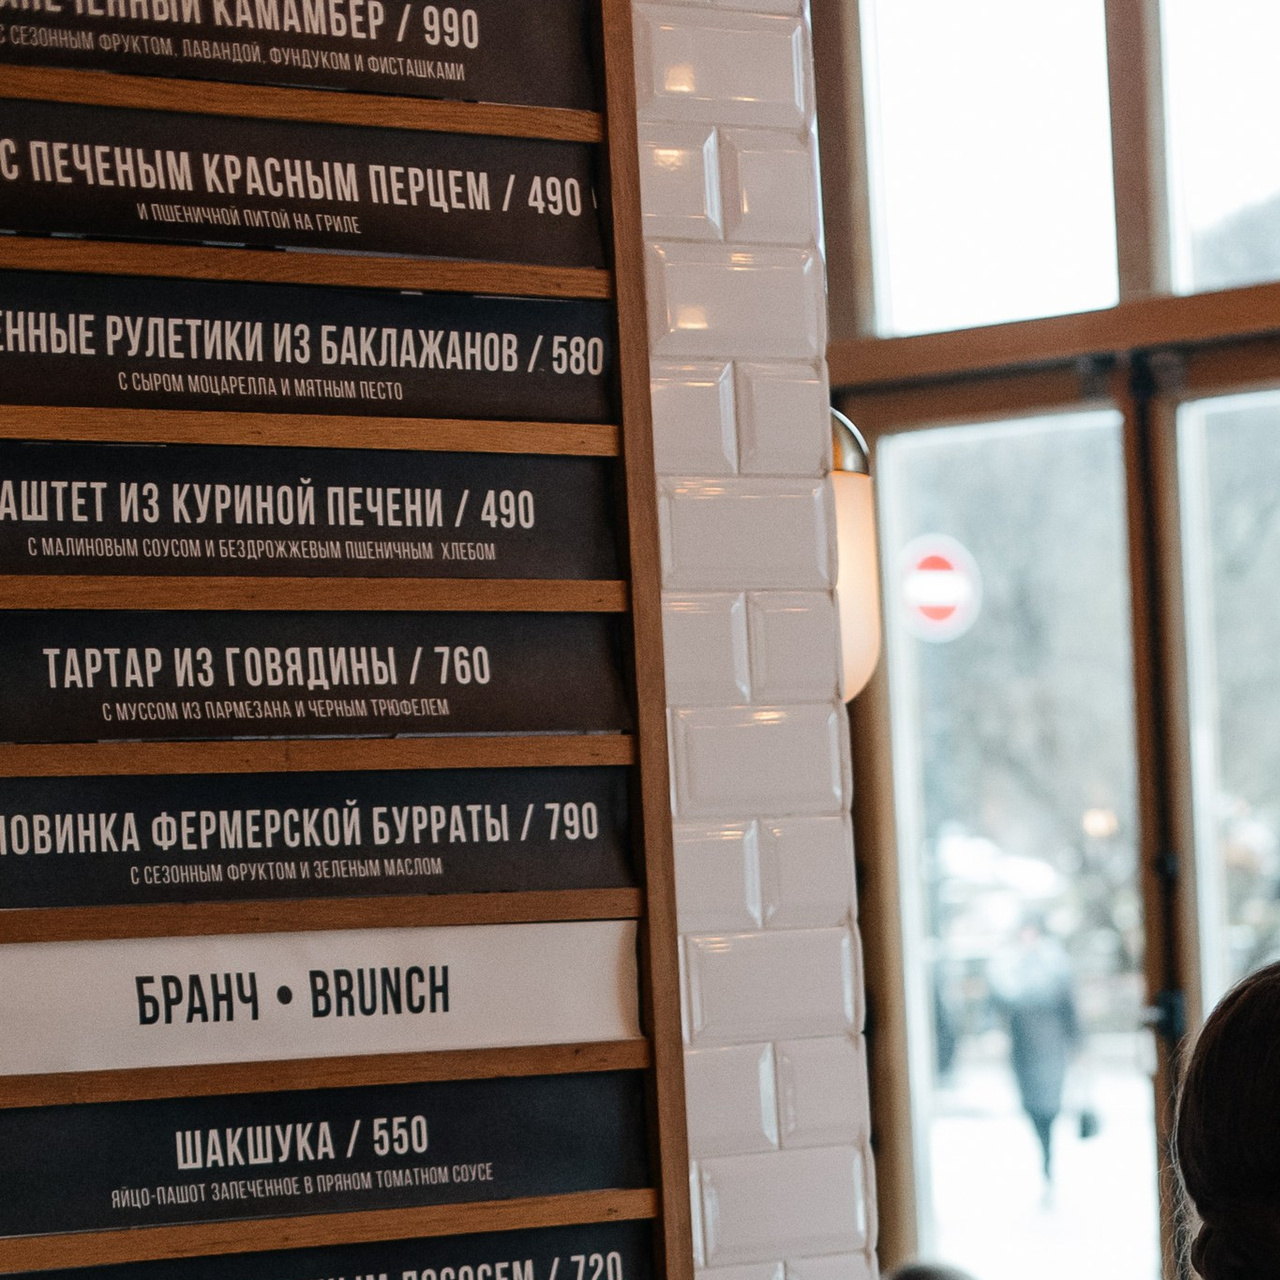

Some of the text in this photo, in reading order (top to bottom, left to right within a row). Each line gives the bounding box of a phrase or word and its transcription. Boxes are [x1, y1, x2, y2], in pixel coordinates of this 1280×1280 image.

[397, 4, 411, 42] /
[423, 5, 479, 49] 990
[10, 25, 94, 49] СЕЗОННЫМ
[269, 47, 351, 71] ФУНДУКОМ
[354, 54, 364, 72] И
[367, 55, 465, 81] ФИСТАШКАМИ
[0, 138, 582, 216] С ПЕЧЕНЫМ КРАСНЫМ ПЕРЦЕМ / 490
[136, 203, 362, 234] И ПШЕНИЧНОЙ ПИТОЙ НА ГРИЛЕ
[106, 315, 263, 362] РУЛЕТИКИ
[274, 323, 310, 364] ИЗ
[321, 325, 518, 372] БАКЛАЖАНОВ
[527, 335, 543, 373] /
[552, 335, 603, 375] 580
[118, 372, 403, 400] С СЫРОМ МОЦАРЕЛЛА И МЯТНЫМ ПЕСТО
[0, 478, 535, 529] АШТЕТ ИЗ КУРИНОЙ ПЕЧЕНИ / 490
[28, 537, 496, 561] С МАЛИНОВЫМ СОУСОМ И БЕЗДРОЖЖЕВЫМ ПШЕНИЧНЫМ ХЛЕБОМ
[43, 646, 490, 690] ТАРТАР ИЗ ГОВЯДИНЫ / 760
[102, 698, 450, 721] С МУССОМ ИЗ ПАРМЕЗАНА И ЧЕРНЫМ ТРЮФЕЛЕМ
[152, 799, 361, 851] ФЕРМЕРСКОЙ
[373, 804, 509, 845] БУРРАТЫ
[520, 803, 534, 841] /
[544, 802, 598, 840] 790
[130, 857, 443, 885] С СЕЗОННЫМ ФРУКТОМ И ЗЕЛЕНЫМ МАСЛОМ
[135, 972, 259, 1025] БРАНЧ
[309, 965, 449, 1018] BRUNCH
[176, 1115, 428, 1170] ШАКШУКА / 550
[111, 1162, 494, 1209] ЯЙЦО-ПАШОТ ЗАПЕЧЕННОЕ В ПРЯНОМ ТОМАТНОМ СОУСЕ
